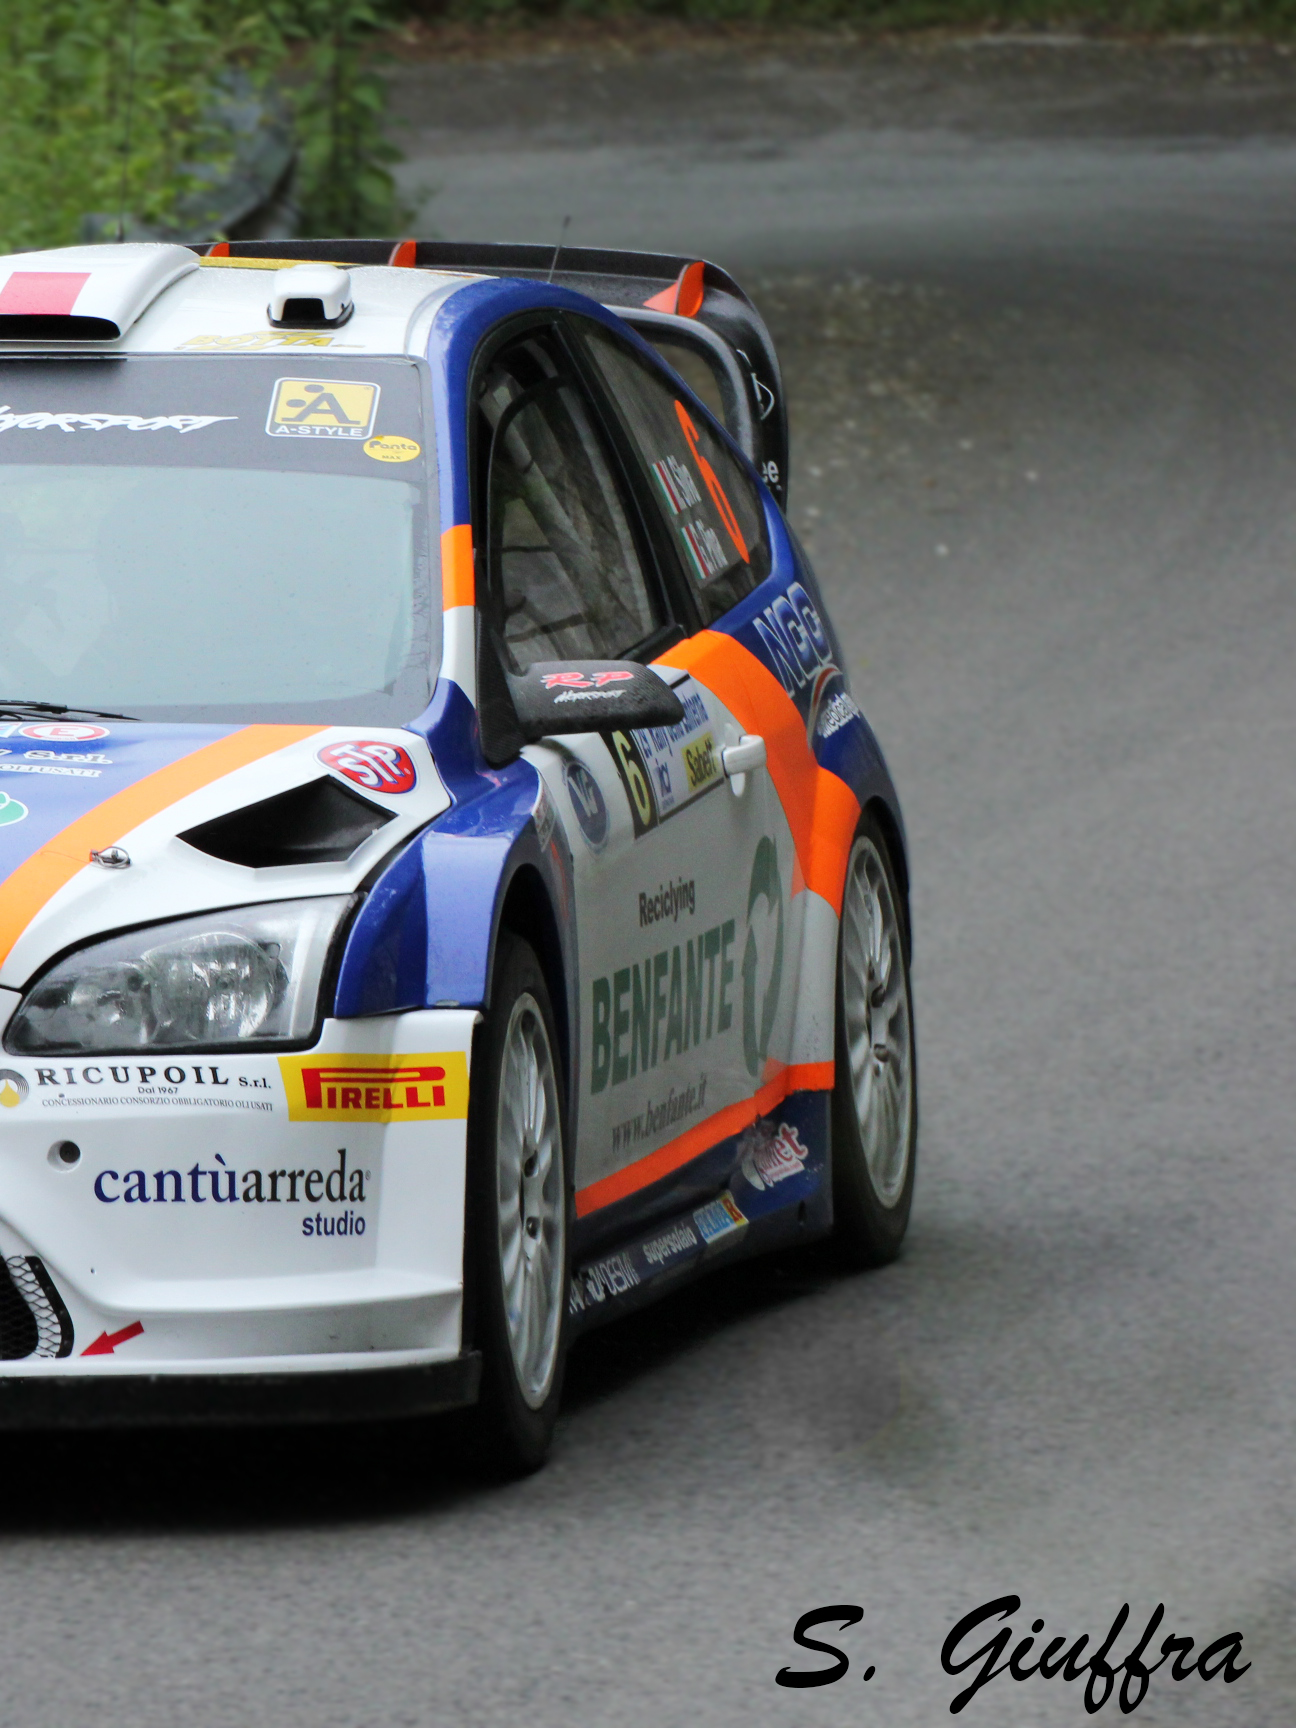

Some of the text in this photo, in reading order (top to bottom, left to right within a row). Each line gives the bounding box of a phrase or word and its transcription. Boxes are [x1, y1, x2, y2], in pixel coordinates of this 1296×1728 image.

[274, 425, 364, 439] A-STYLE
[368, 440, 418, 451] Panta
[674, 400, 750, 564] 6
[328, 744, 406, 788] STP
[612, 730, 651, 826] 6
[638, 877, 695, 928] Reciclying
[591, 918, 735, 1095] BENFANTE
[35, 1065, 272, 1089] RICUPOIL S.r.l.
[138, 1086, 179, 1095] Dal 1967
[301, 1066, 446, 1110] PIRELLI
[42, 1097, 118, 1107] CONCESSIONARIO
[120, 1096, 170, 1106] CONSORZIO
[172, 1097, 233, 1108] OBBLIGATORIO
[250, 1101, 274, 1112] USATI
[612, 1072, 707, 1151] www.benfante.it
[93, 1148, 366, 1204] cantùarreda
[302, 1212, 366, 1237] studio
